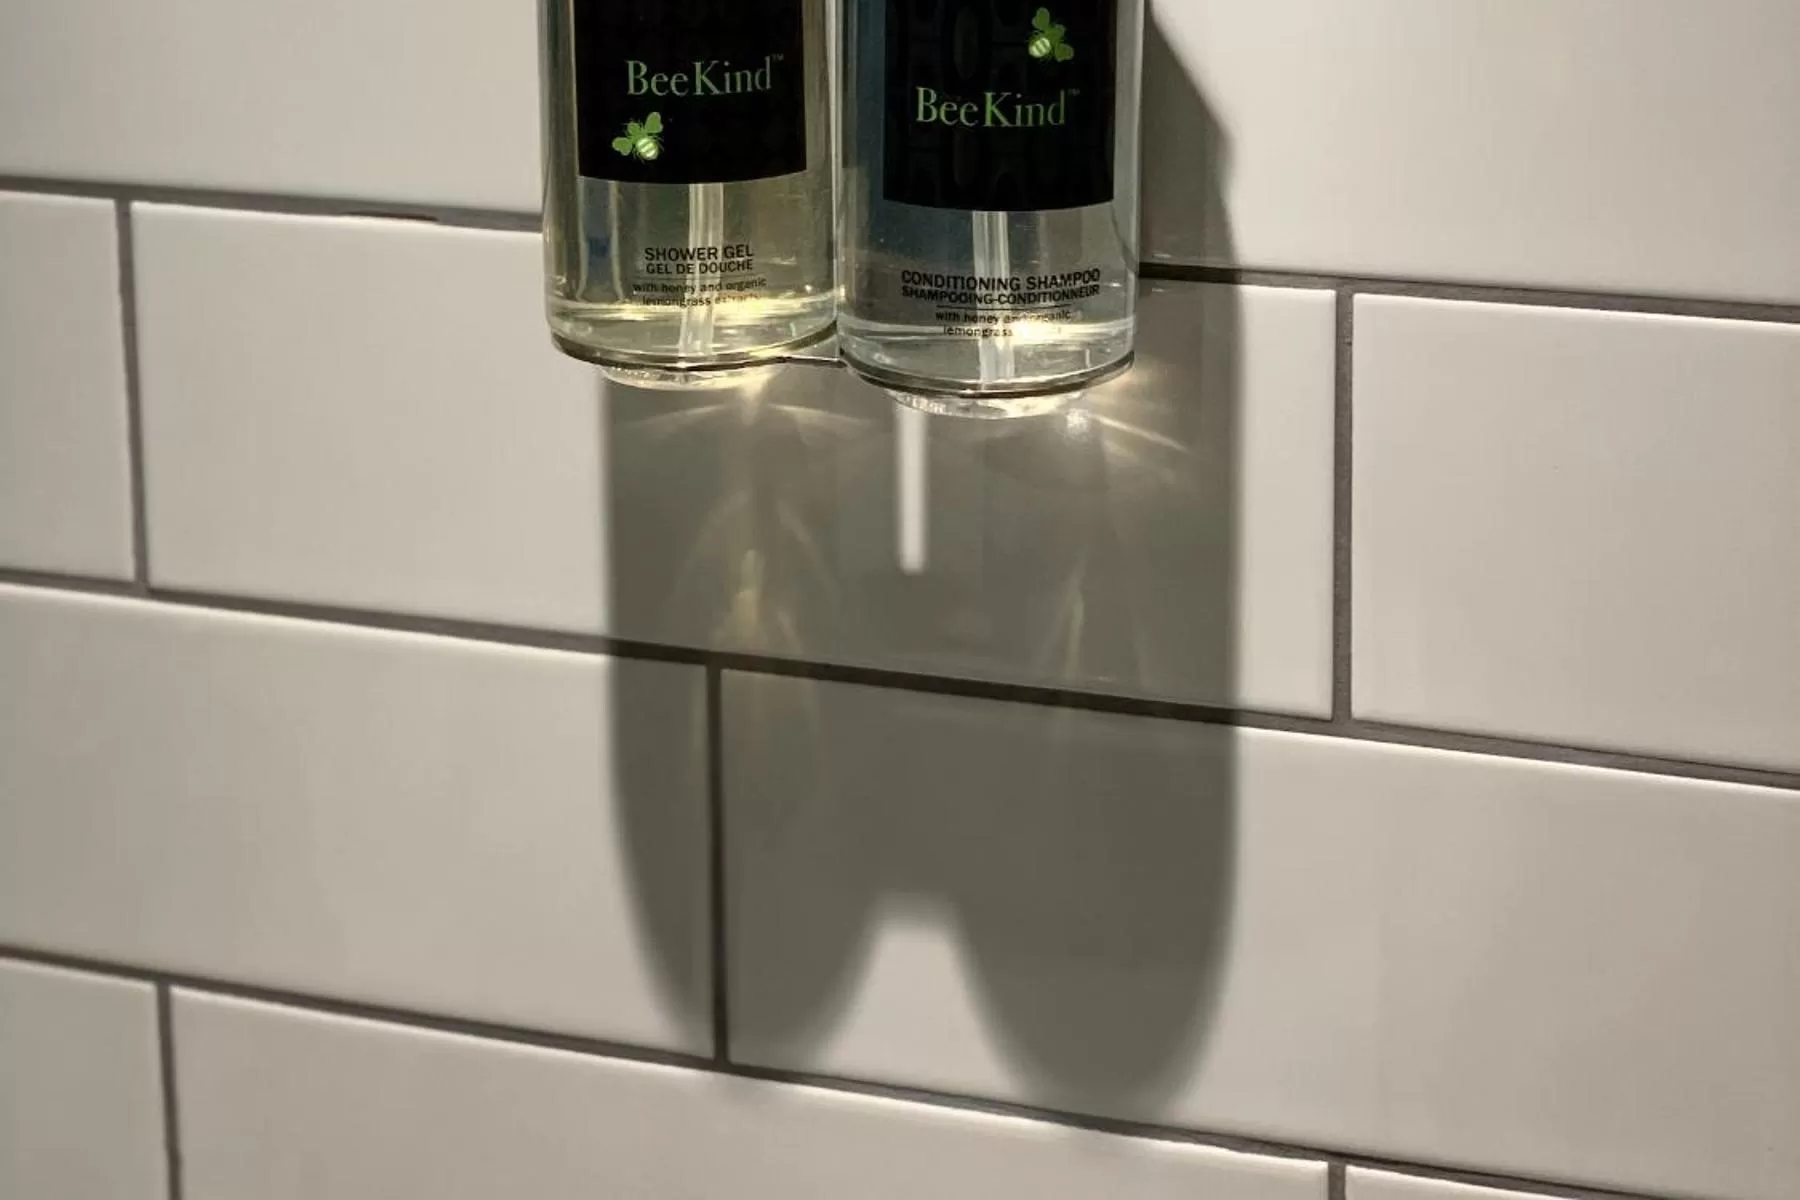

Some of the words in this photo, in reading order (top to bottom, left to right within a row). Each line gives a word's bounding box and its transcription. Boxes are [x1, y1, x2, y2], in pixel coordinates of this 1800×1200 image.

[644, 246, 718, 262] SHOWER
[723, 244, 755, 259] GEL
[646, 263, 672, 275] GEL
[675, 262, 695, 275] DE
[699, 259, 753, 275] DOUCHE
[632, 281, 656, 292] with
[660, 282, 696, 294] honey
[700, 281, 722, 292] and
[725, 277, 767, 292] organic
[901, 270, 1021, 291] CONDITIONING
[1026, 268, 1101, 289] SHAMPOO
[935, 311, 961, 323] with
[963, 312, 999, 325] honey
